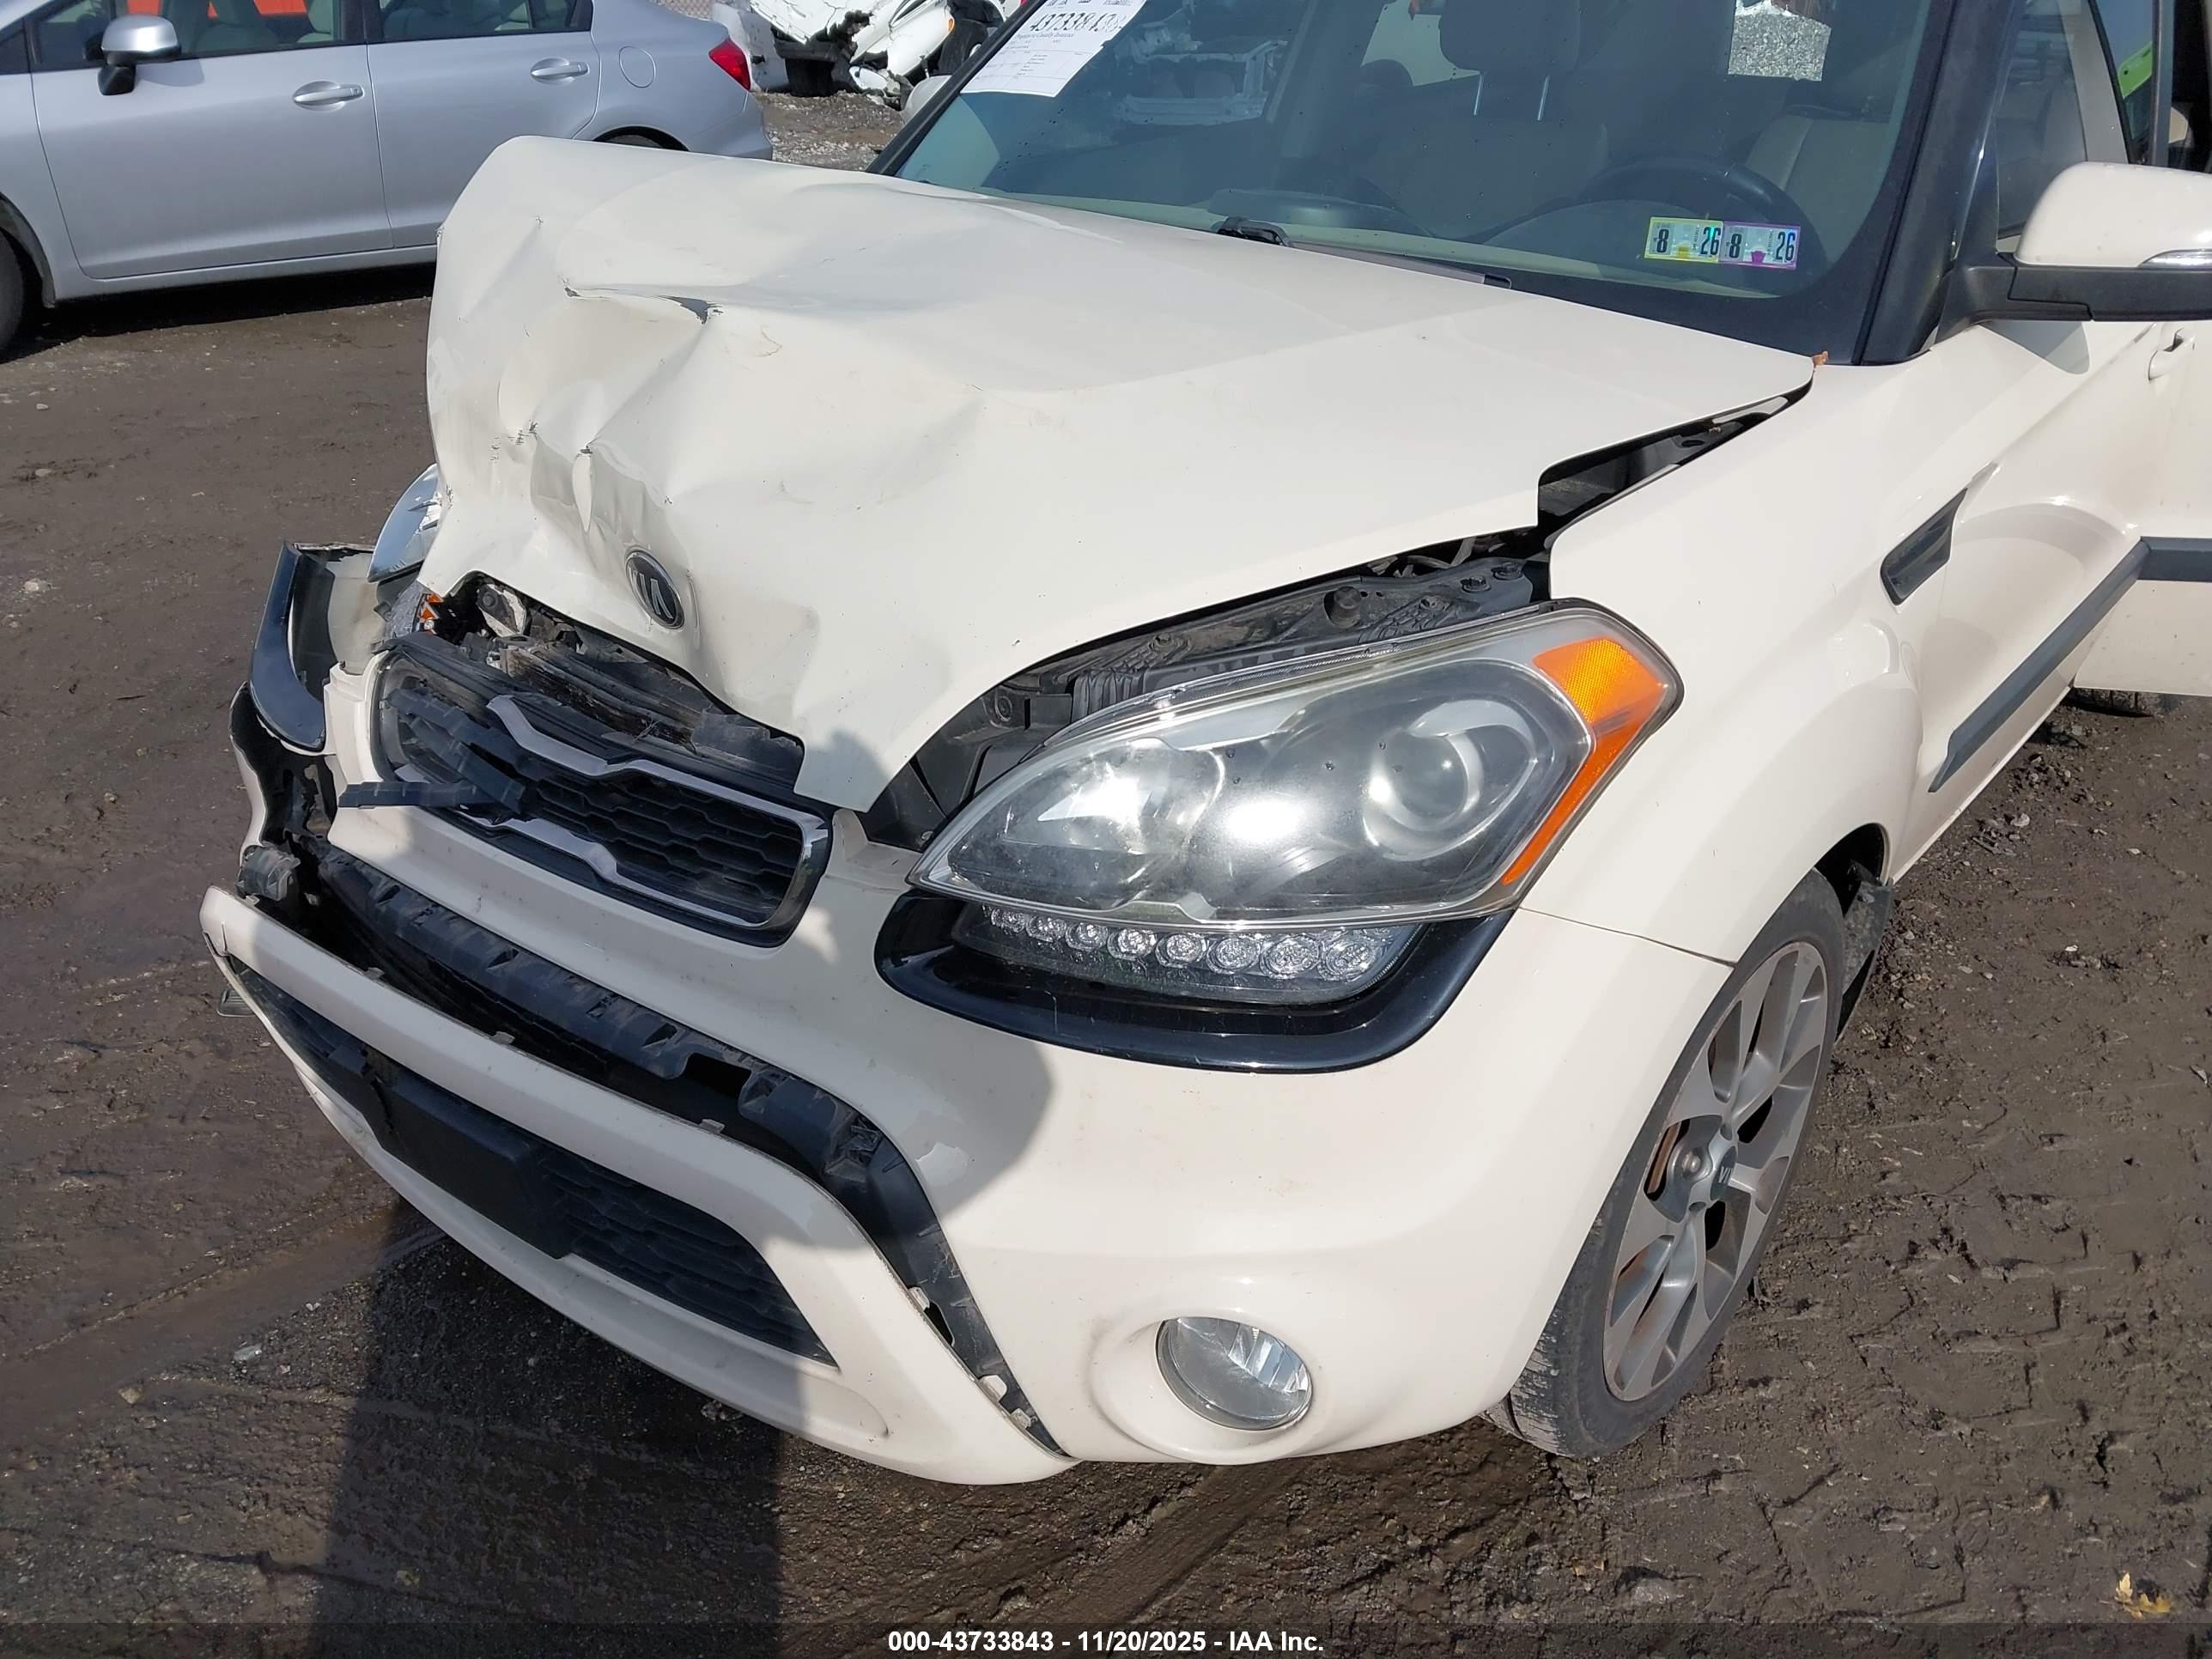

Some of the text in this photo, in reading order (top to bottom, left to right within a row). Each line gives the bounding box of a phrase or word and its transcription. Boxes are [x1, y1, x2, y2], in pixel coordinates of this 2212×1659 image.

[1656, 228, 1669, 253] 8
[1700, 226, 1722, 256] 26
[1729, 233, 1742, 258] 8
[1775, 231, 1796, 261] 26
